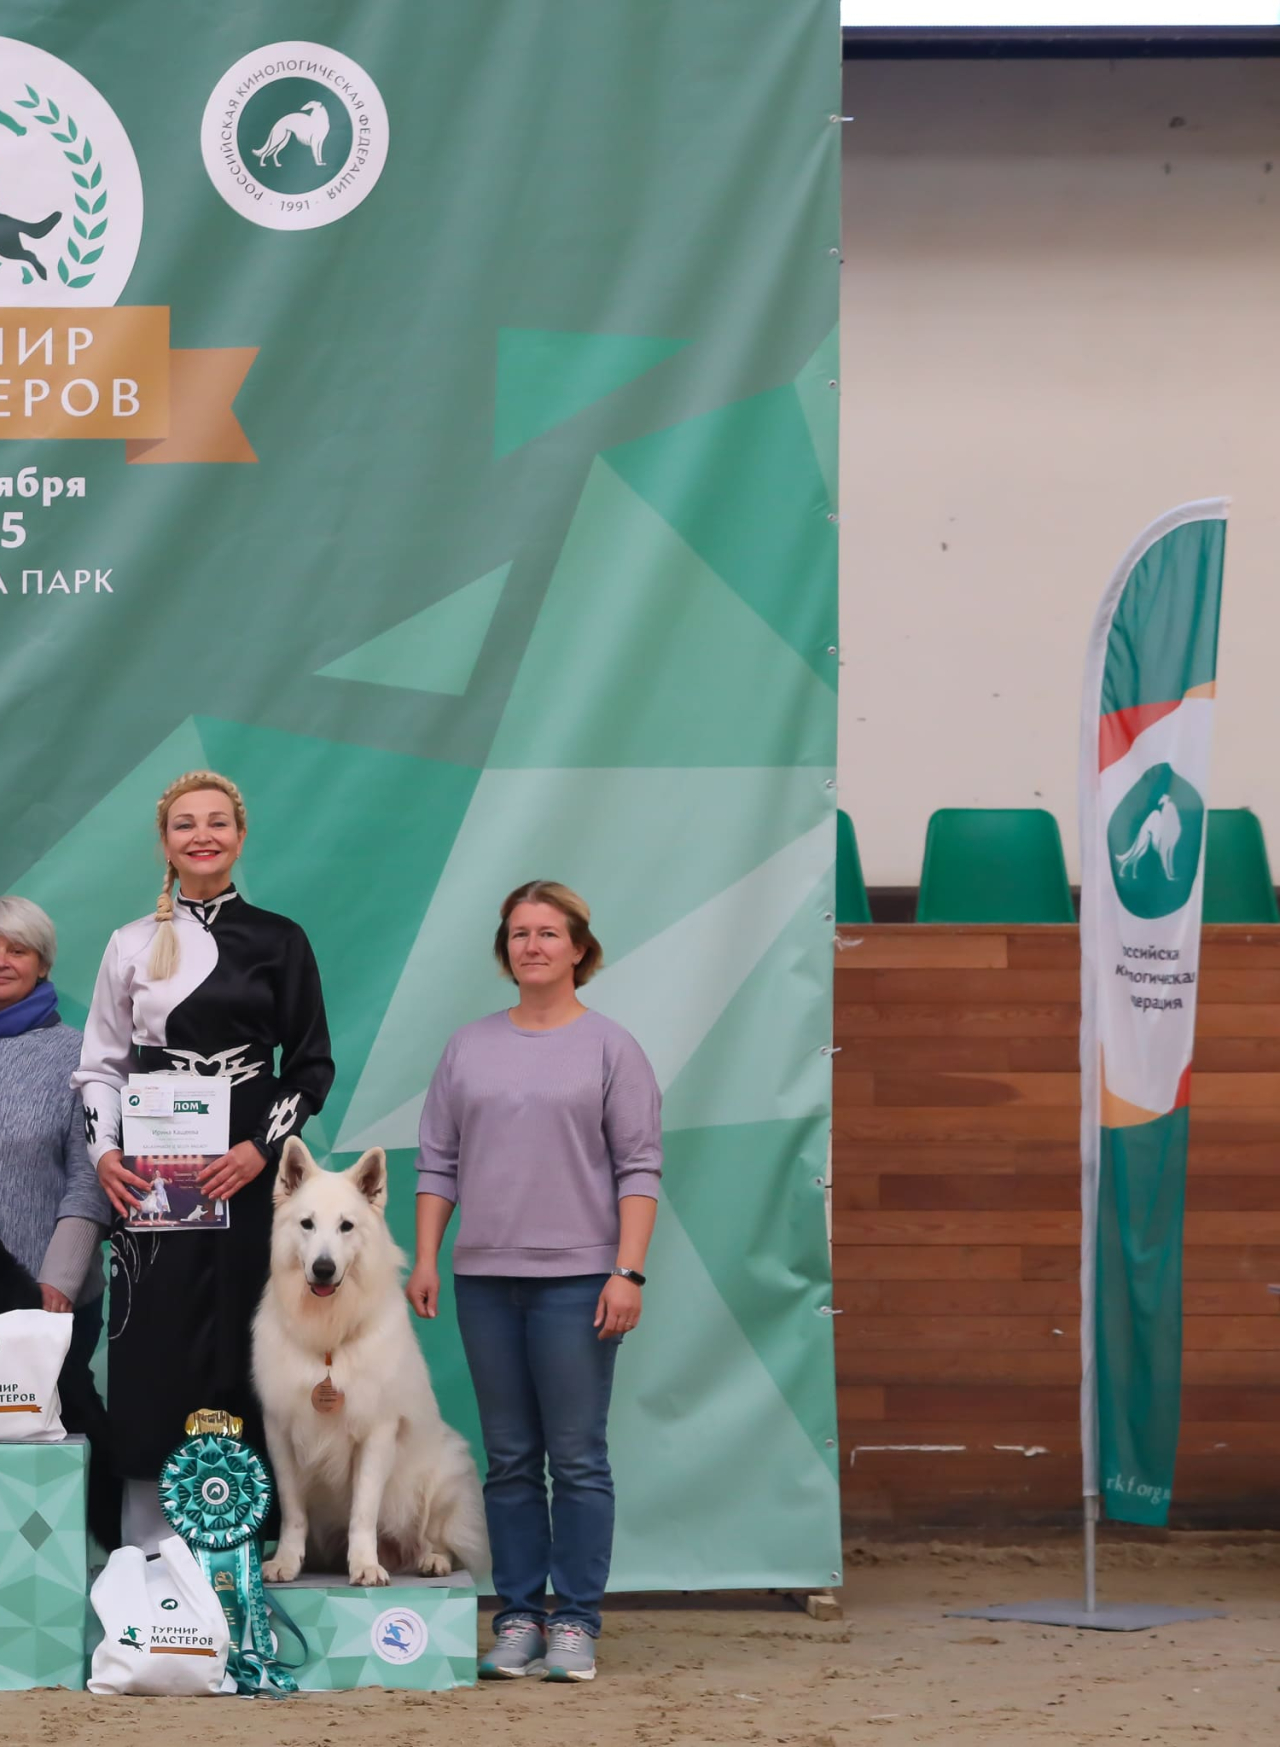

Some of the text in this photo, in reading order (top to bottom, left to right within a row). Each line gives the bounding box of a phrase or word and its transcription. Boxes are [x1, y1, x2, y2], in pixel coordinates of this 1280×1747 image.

[220, 60, 371, 201] РОССИЙСКАЯ КИНОЛОГИЧЕСКАЯ ФЕДЕРАЦИЯ
[280, 200, 310, 212] 1991
[22, 568, 114, 594] ПАРК
[174, 1102, 199, 1111] ЛОМ
[151, 1625, 199, 1635] ТУРНИР
[150, 1635, 213, 1646] МАСТЕРОВ
